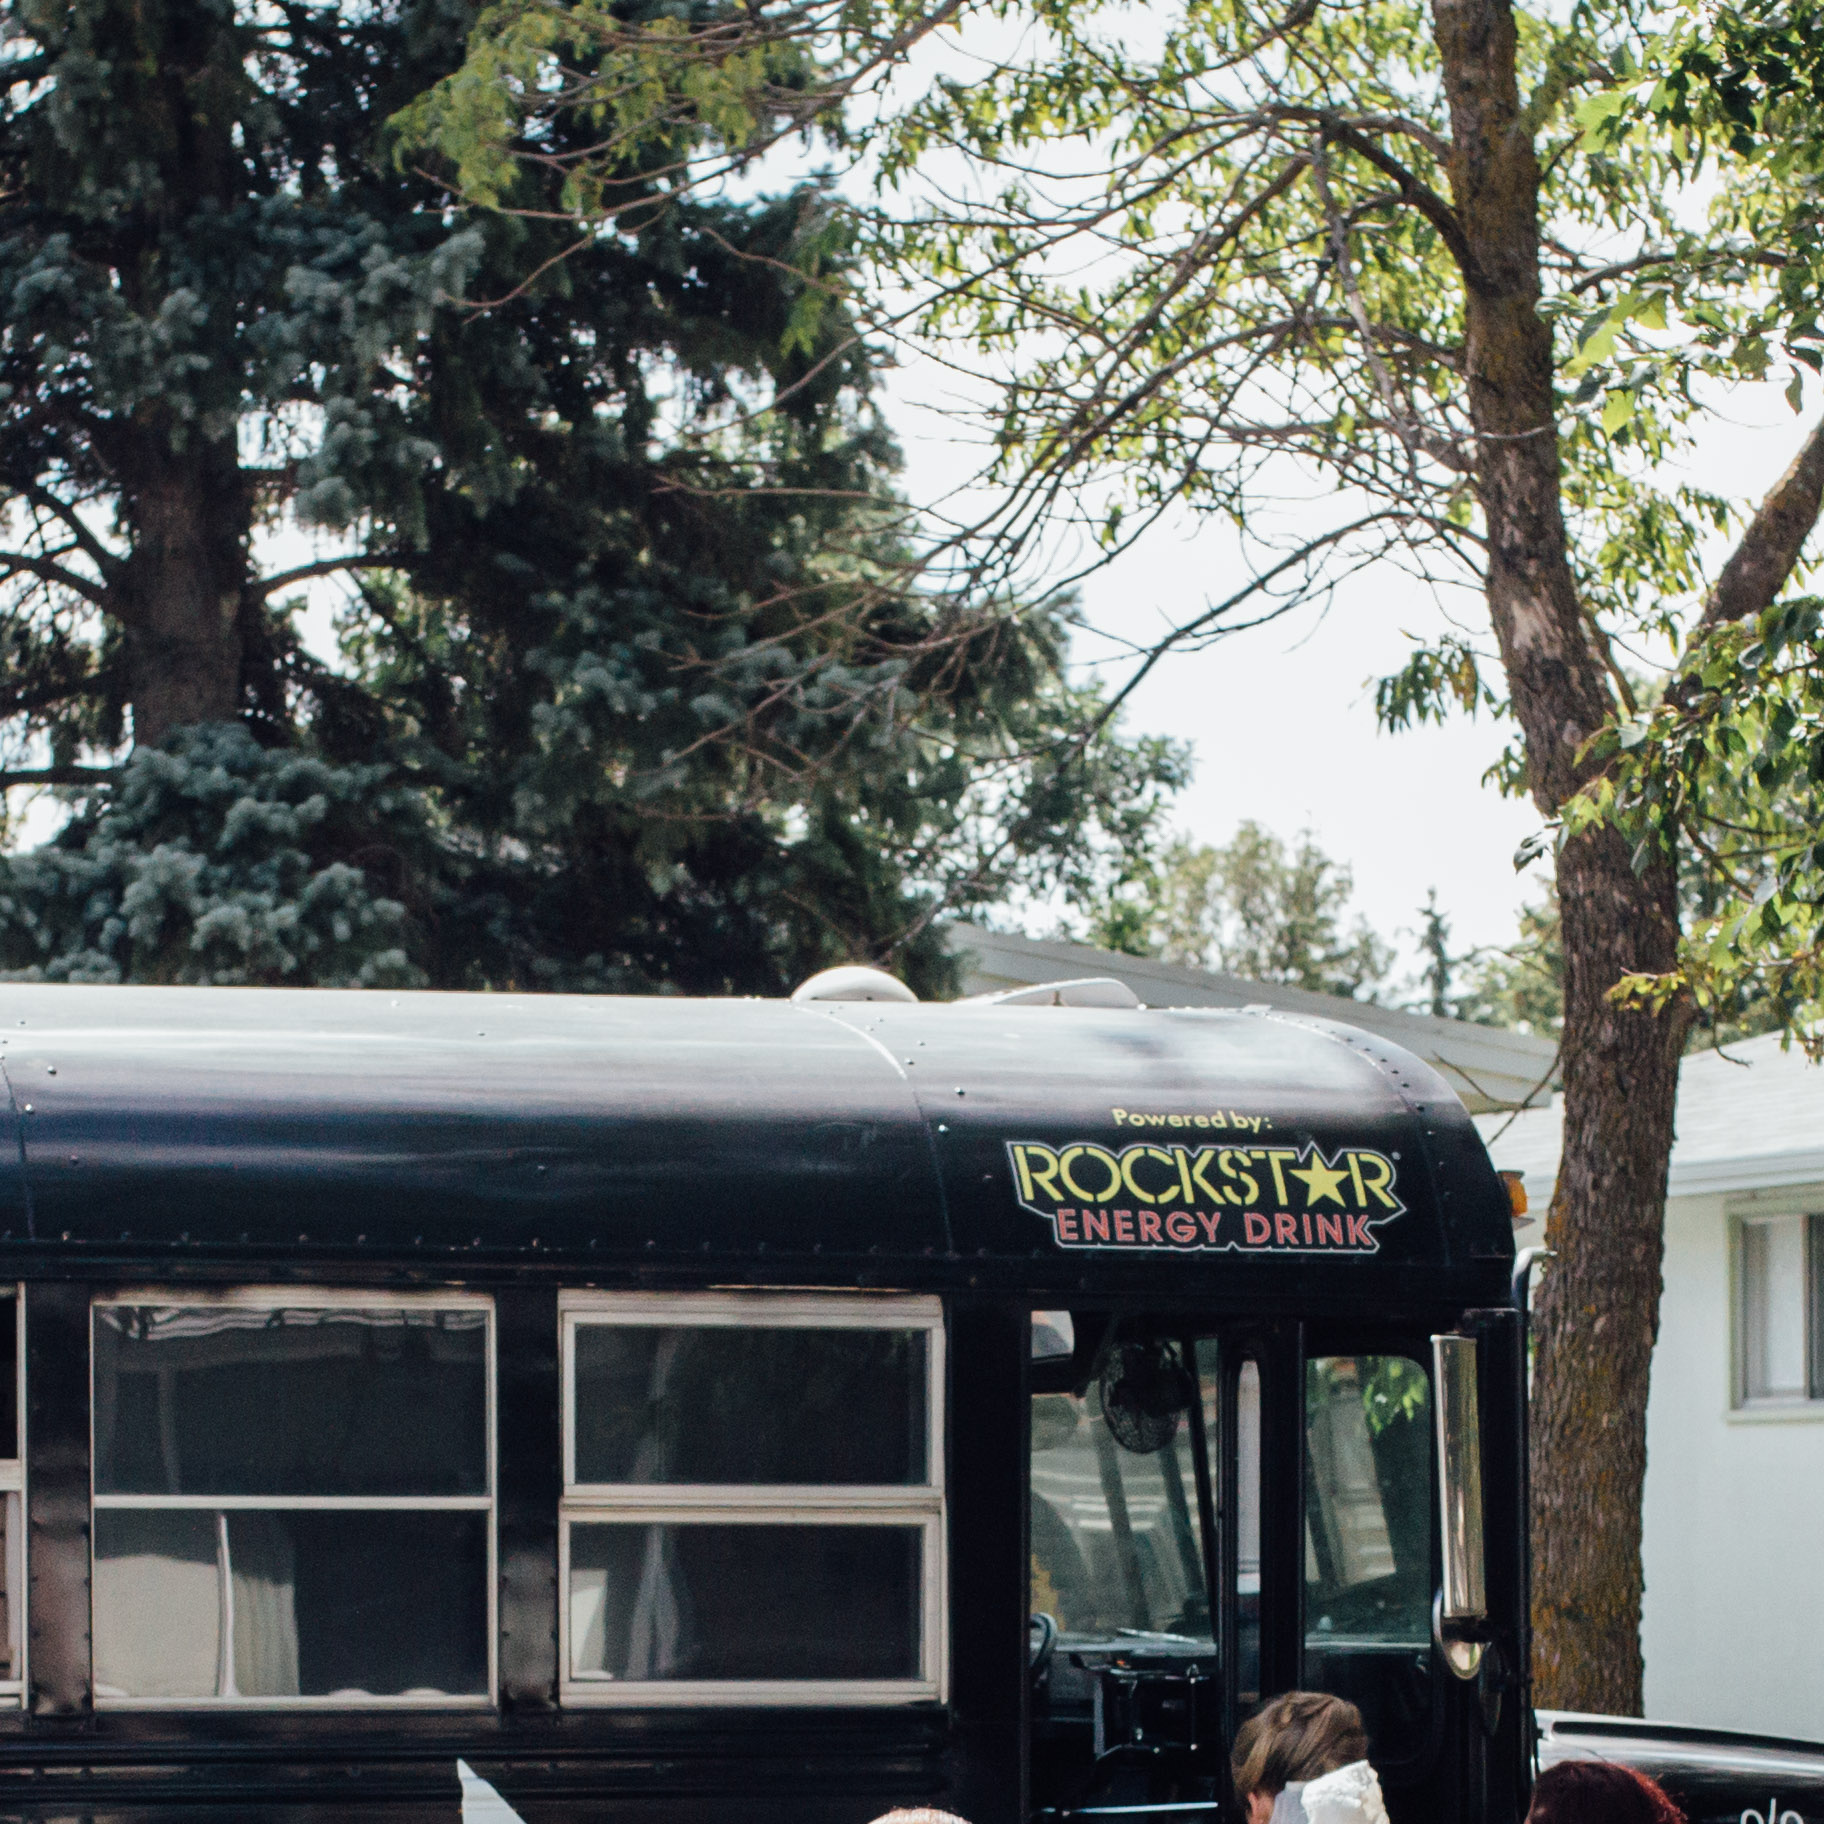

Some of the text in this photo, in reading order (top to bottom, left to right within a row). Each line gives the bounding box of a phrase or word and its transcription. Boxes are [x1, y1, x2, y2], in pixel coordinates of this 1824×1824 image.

[1111, 1107, 1273, 1134] Powered by:
[1056, 1208, 1373, 1246] ENERGY DRINK
